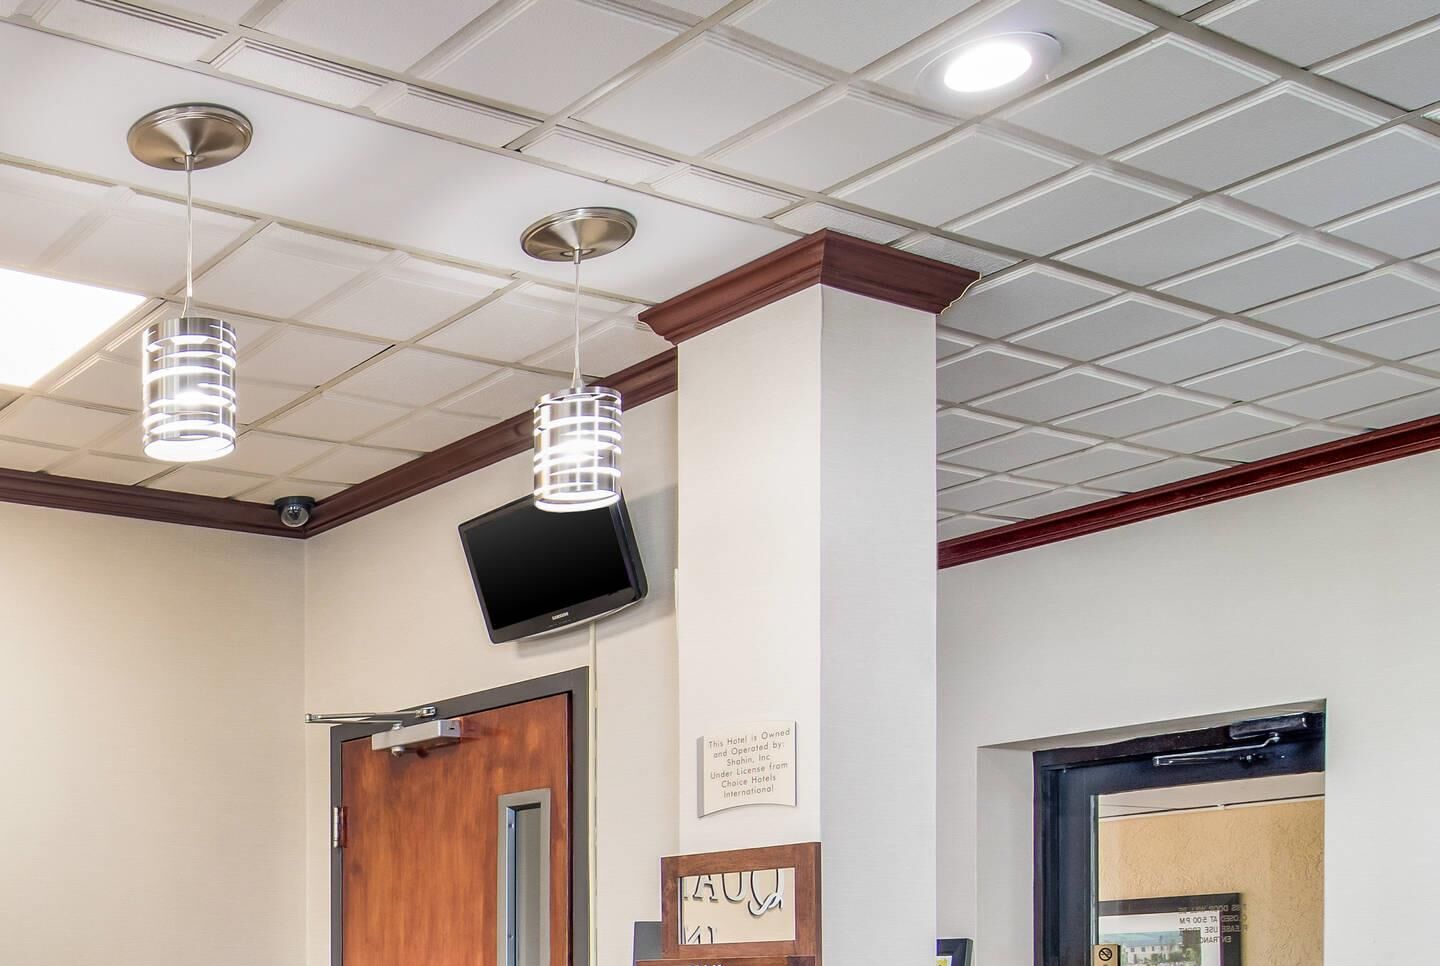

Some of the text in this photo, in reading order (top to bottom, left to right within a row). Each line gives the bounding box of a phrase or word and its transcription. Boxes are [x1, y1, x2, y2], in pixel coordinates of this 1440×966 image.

[708, 741, 724, 749] This
[727, 735, 748, 745] Hotel
[761, 728, 791, 740] Owned
[713, 749, 728, 759] and
[731, 742, 769, 756] Operated
[710, 762, 788, 780] Under License from
[721, 773, 777, 789] Choice Hotels
[723, 784, 774, 799] International
